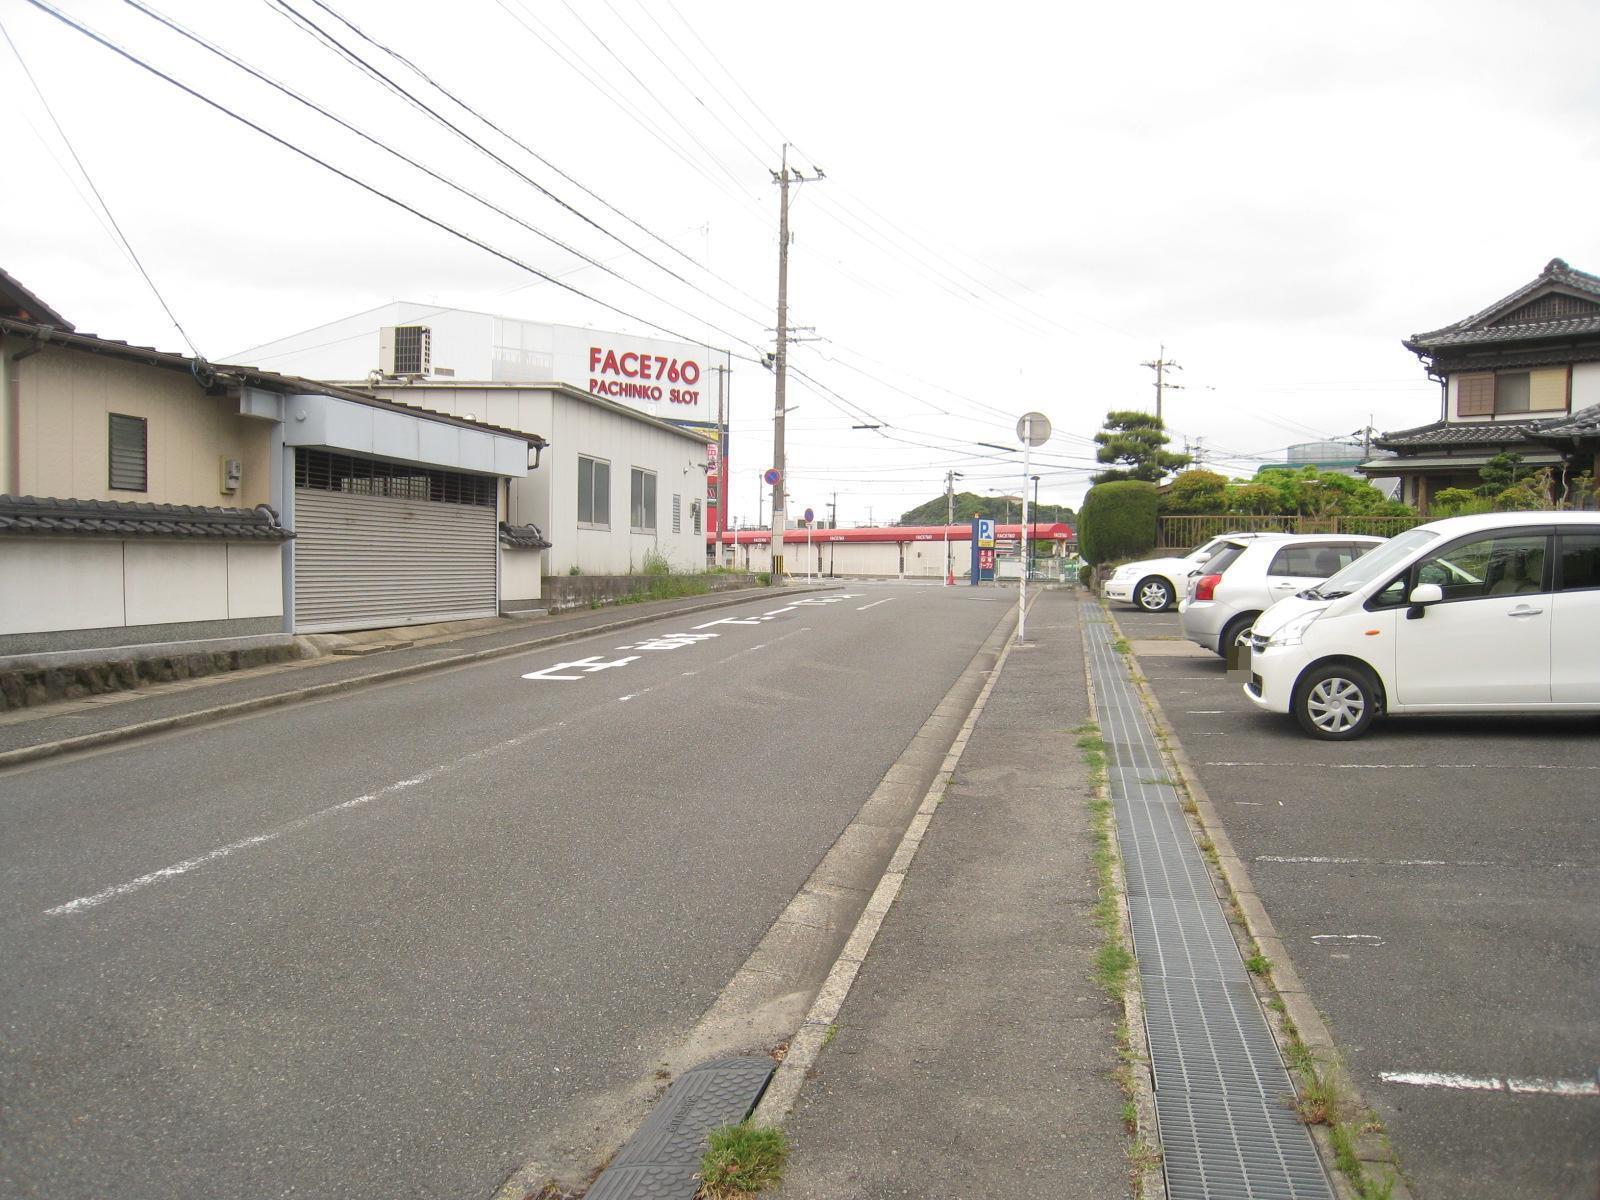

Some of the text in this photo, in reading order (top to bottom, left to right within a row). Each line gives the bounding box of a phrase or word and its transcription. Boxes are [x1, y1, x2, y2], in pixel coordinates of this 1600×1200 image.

[590, 347, 700, 385] FACE760
[589, 378, 700, 405] PACHINKO SLOT
[980, 521, 989, 539] P
